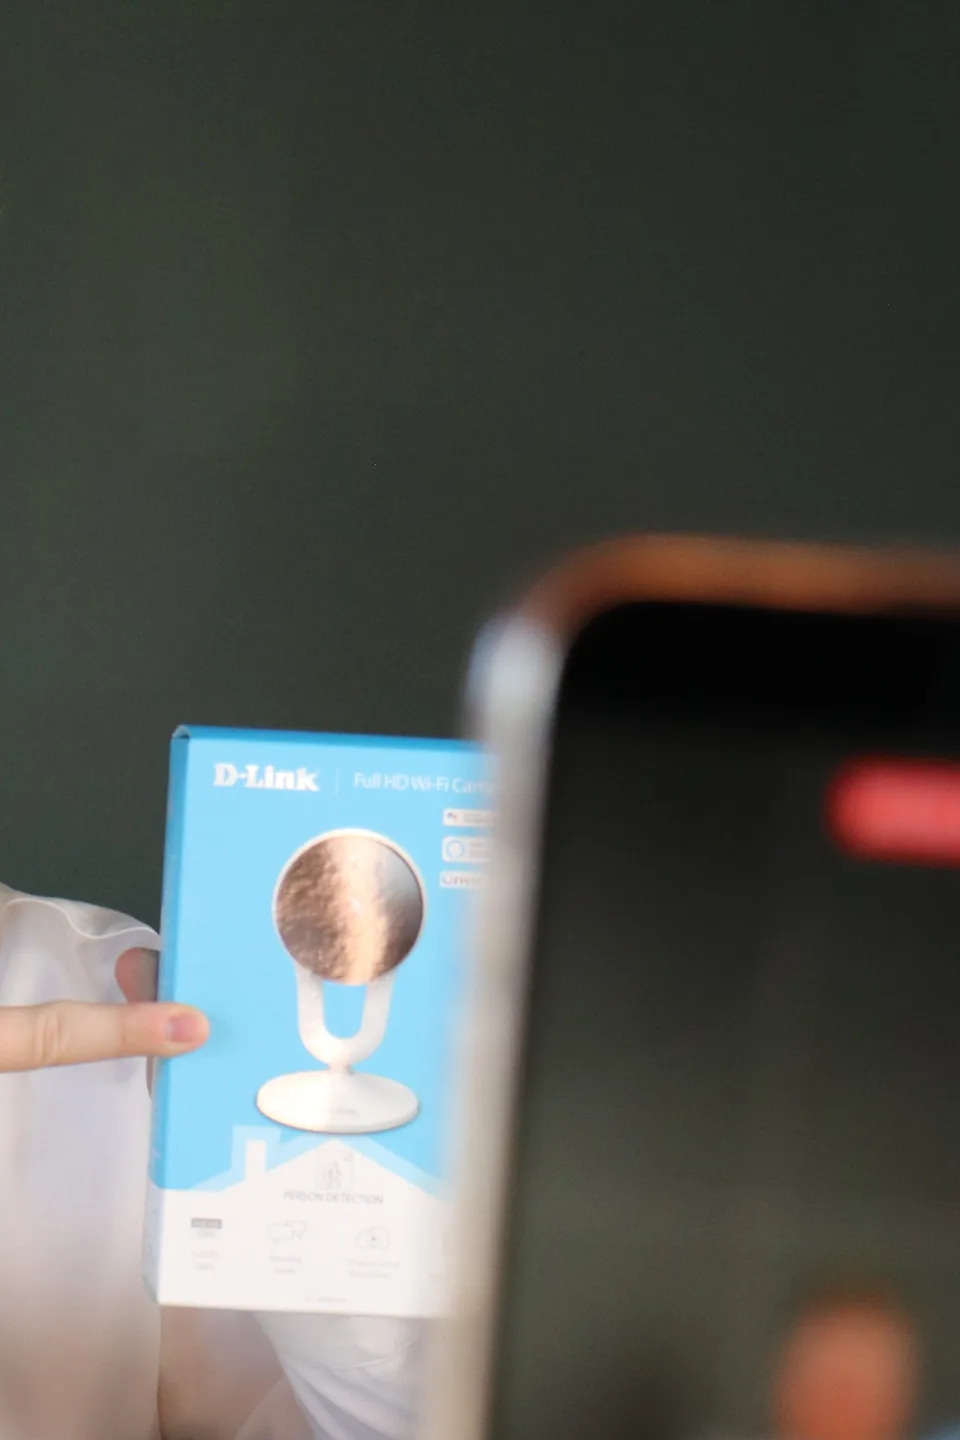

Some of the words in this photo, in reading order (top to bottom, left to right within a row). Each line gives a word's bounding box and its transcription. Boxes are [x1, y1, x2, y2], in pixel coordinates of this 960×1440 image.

[213, 762, 320, 792] D-Link
[353, 772, 381, 790] Full
[383, 773, 409, 791] HD
[411, 775, 449, 793] Wi-Fi
[283, 1190, 324, 1203] PERSON
[325, 1192, 384, 1206] DETECTION
